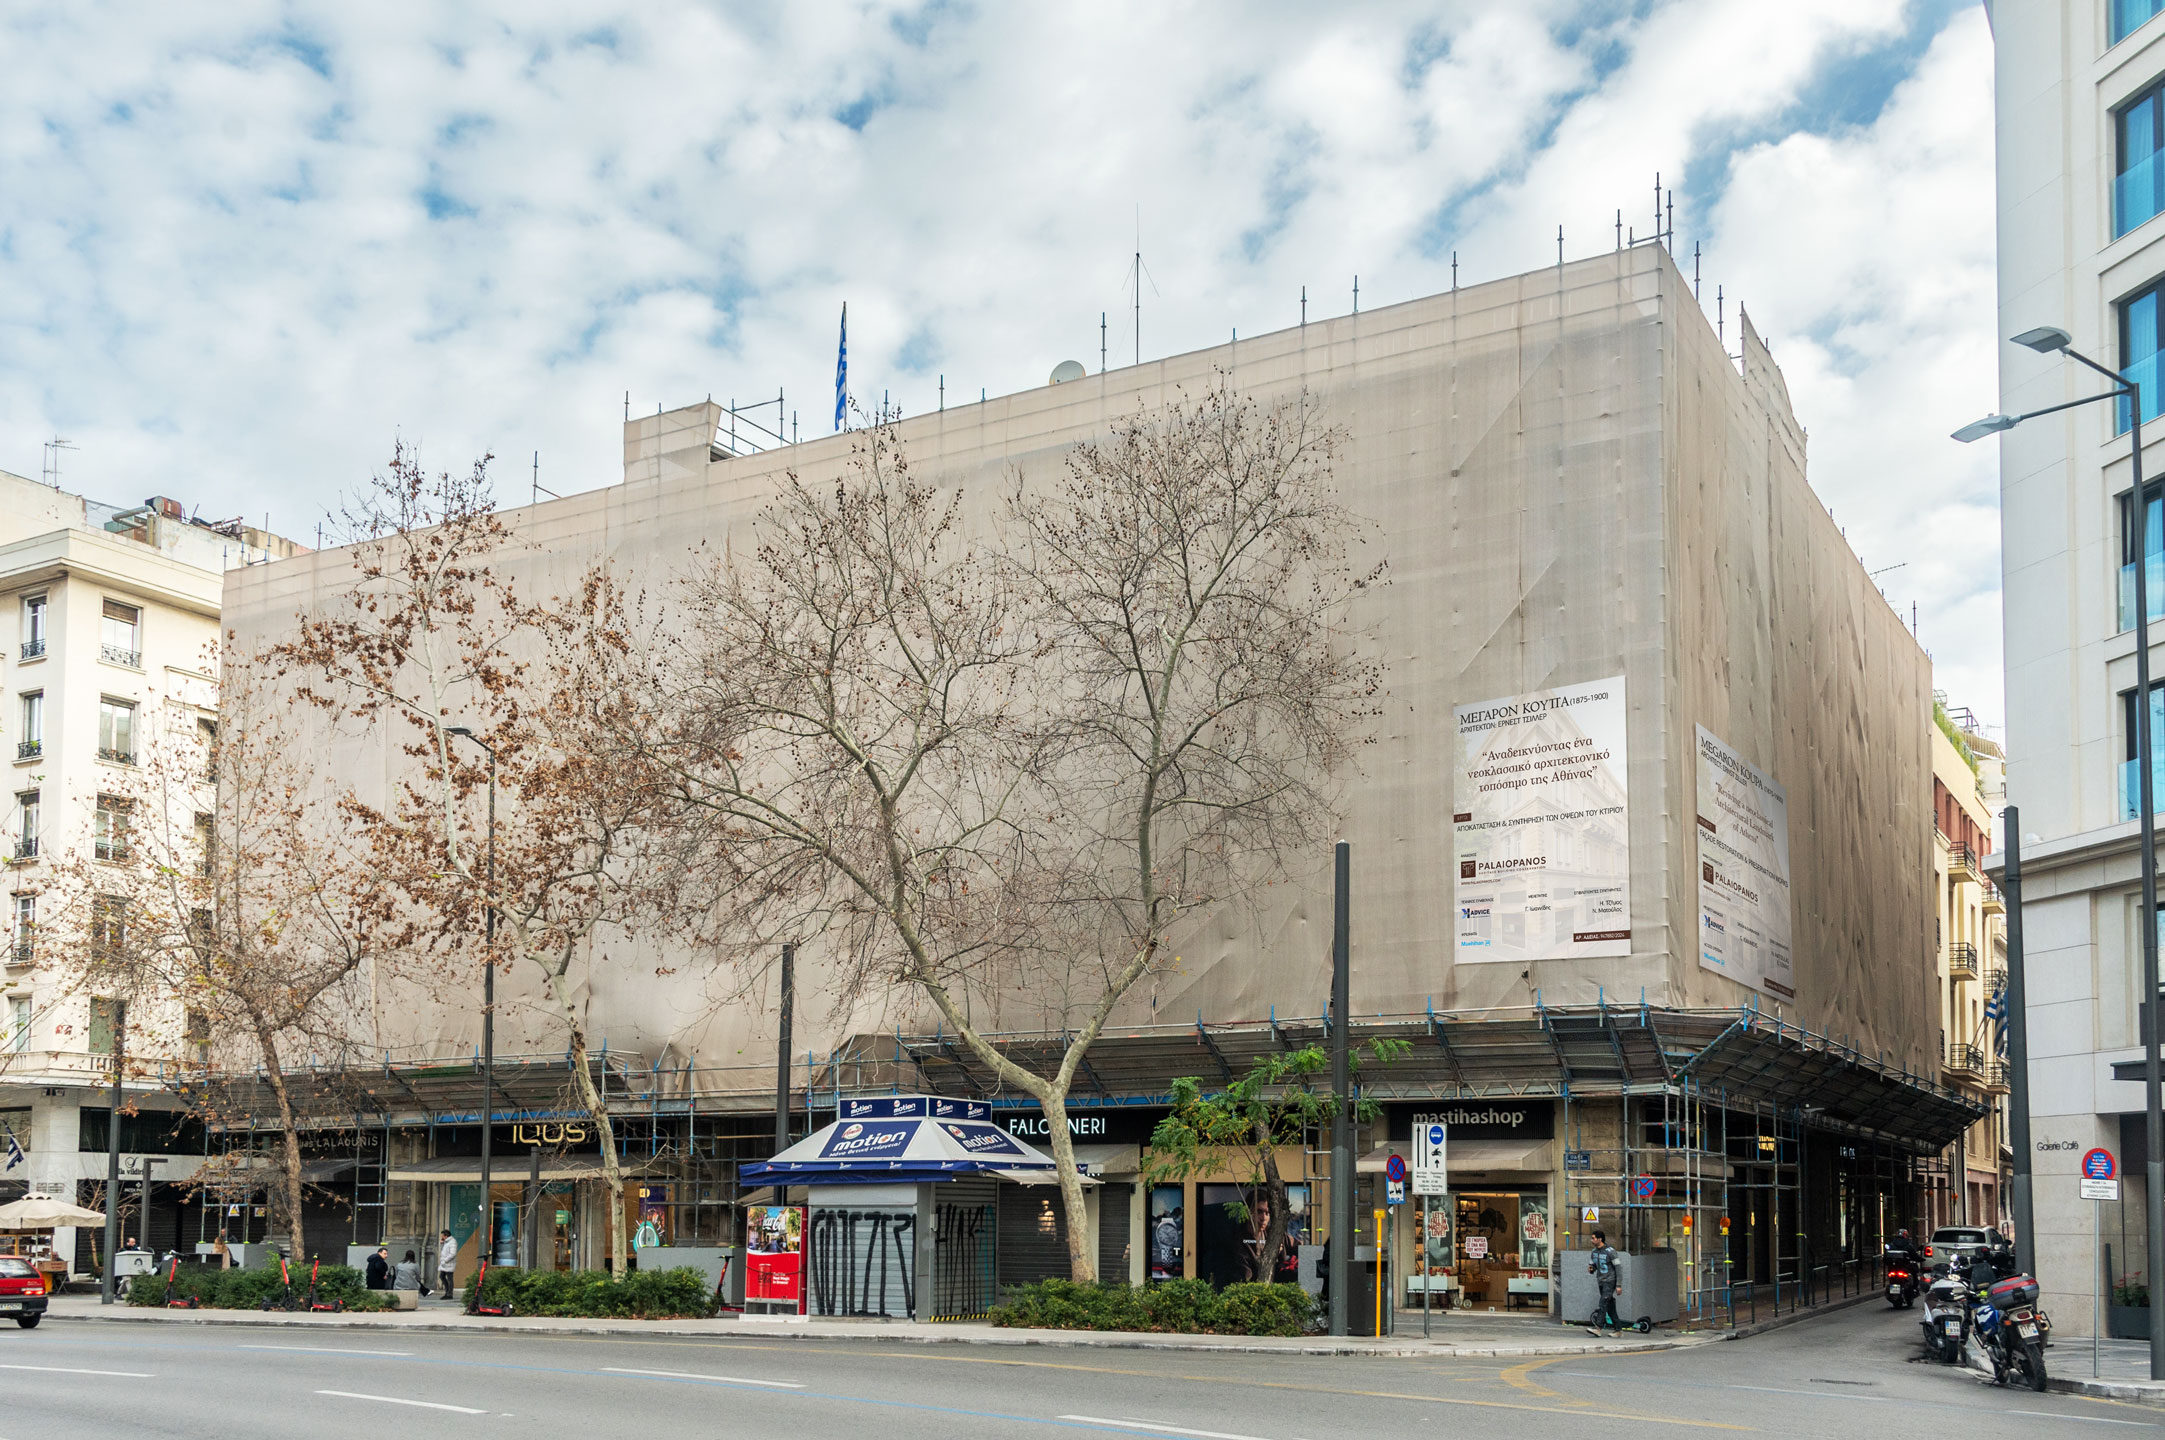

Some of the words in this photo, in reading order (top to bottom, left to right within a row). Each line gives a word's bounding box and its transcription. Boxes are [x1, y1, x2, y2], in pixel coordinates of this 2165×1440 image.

[1460, 704, 1519, 725] ΜΕΓΑΡΟΝ
[1570, 691, 1609, 706] (1875-1900)
[1497, 717, 1521, 728] ΕΡΝΕΣΤ
[1574, 737, 1593, 747] ένα
[1467, 759, 1531, 779] νεοκλασσικό
[1533, 749, 1610, 773] αρχιτεκτονικό
[1700, 735, 1740, 772] MEGARON
[1740, 765, 1764, 791] KOUPA
[1479, 777, 1528, 793] τοπόσημο
[1530, 774, 1549, 787] της
[1456, 820, 1501, 832] ΑΠΟΚΑΤΑΣΤΑΣΗ
[1508, 815, 1545, 827] ΣΥΝΤΗΡΗΣΗ
[1546, 813, 1559, 822] ΤΩΝ
[1559, 811, 1584, 821] ΟΨΕΩΝ
[1585, 809, 1598, 817] ΤΟΥ
[1599, 806, 1625, 815] ΚΤΙΡΙΟΥ
[1732, 822, 1739, 832] of
[1716, 839, 1746, 862] RESTORATION
[1478, 856, 1547, 871] PALAIOPANOS
[1715, 871, 1759, 903] PALAIOPANOS
[1470, 908, 1490, 916] ADVICE
[1710, 920, 1725, 932] ADVICE
[850, 1103, 873, 1115] motion
[893, 1102, 916, 1114] motion
[936, 1103, 954, 1114] motion
[967, 1106, 984, 1116] motion
[1412, 1108, 1525, 1128] mastihashop
[1009, 1117, 1106, 1135] FALCNERI
[316, 1135, 379, 1148] LALAOUNIS
[832, 1131, 907, 1152] motion
[962, 1133, 1004, 1149] motion
[2061, 1140, 2079, 1151] Café
